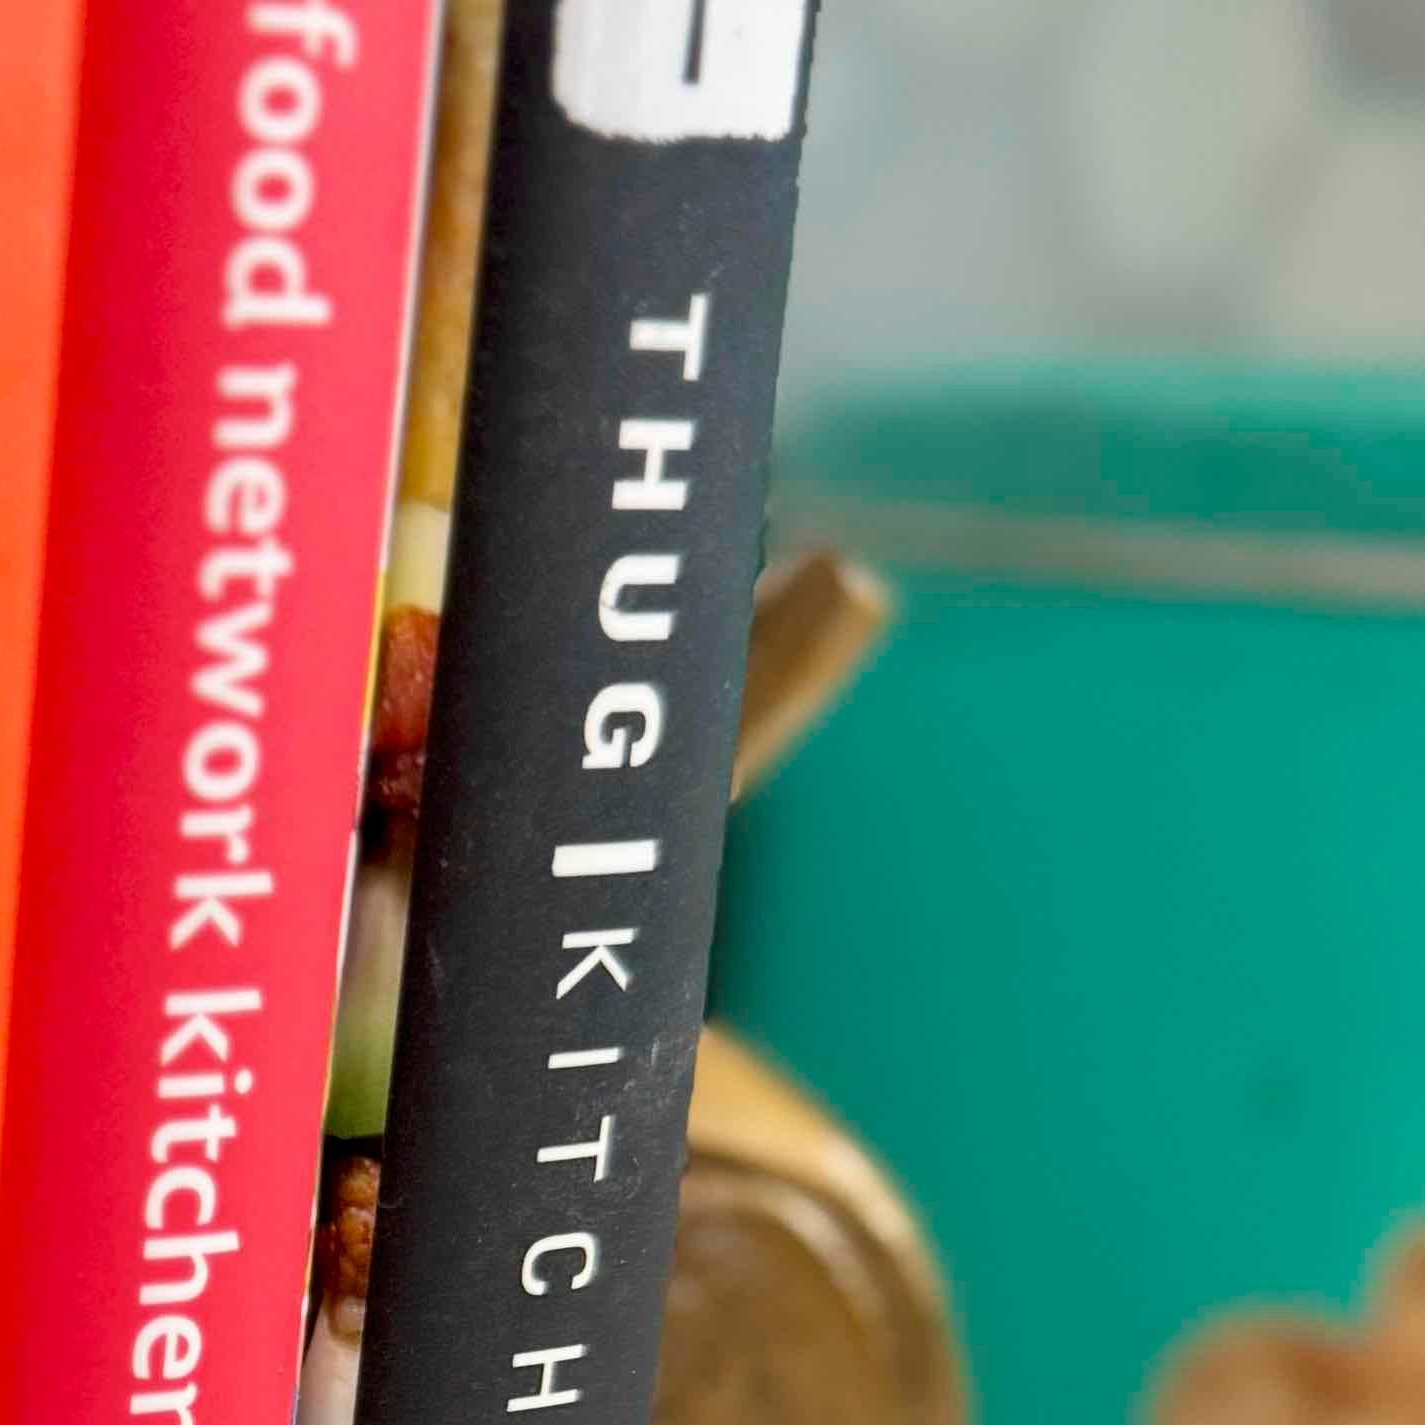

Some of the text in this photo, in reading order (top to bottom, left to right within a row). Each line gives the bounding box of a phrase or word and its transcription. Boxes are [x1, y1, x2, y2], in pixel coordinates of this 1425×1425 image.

[222, 0, 361, 328] food
[168, 362, 299, 950] network
[579, 290, 711, 772] THUG
